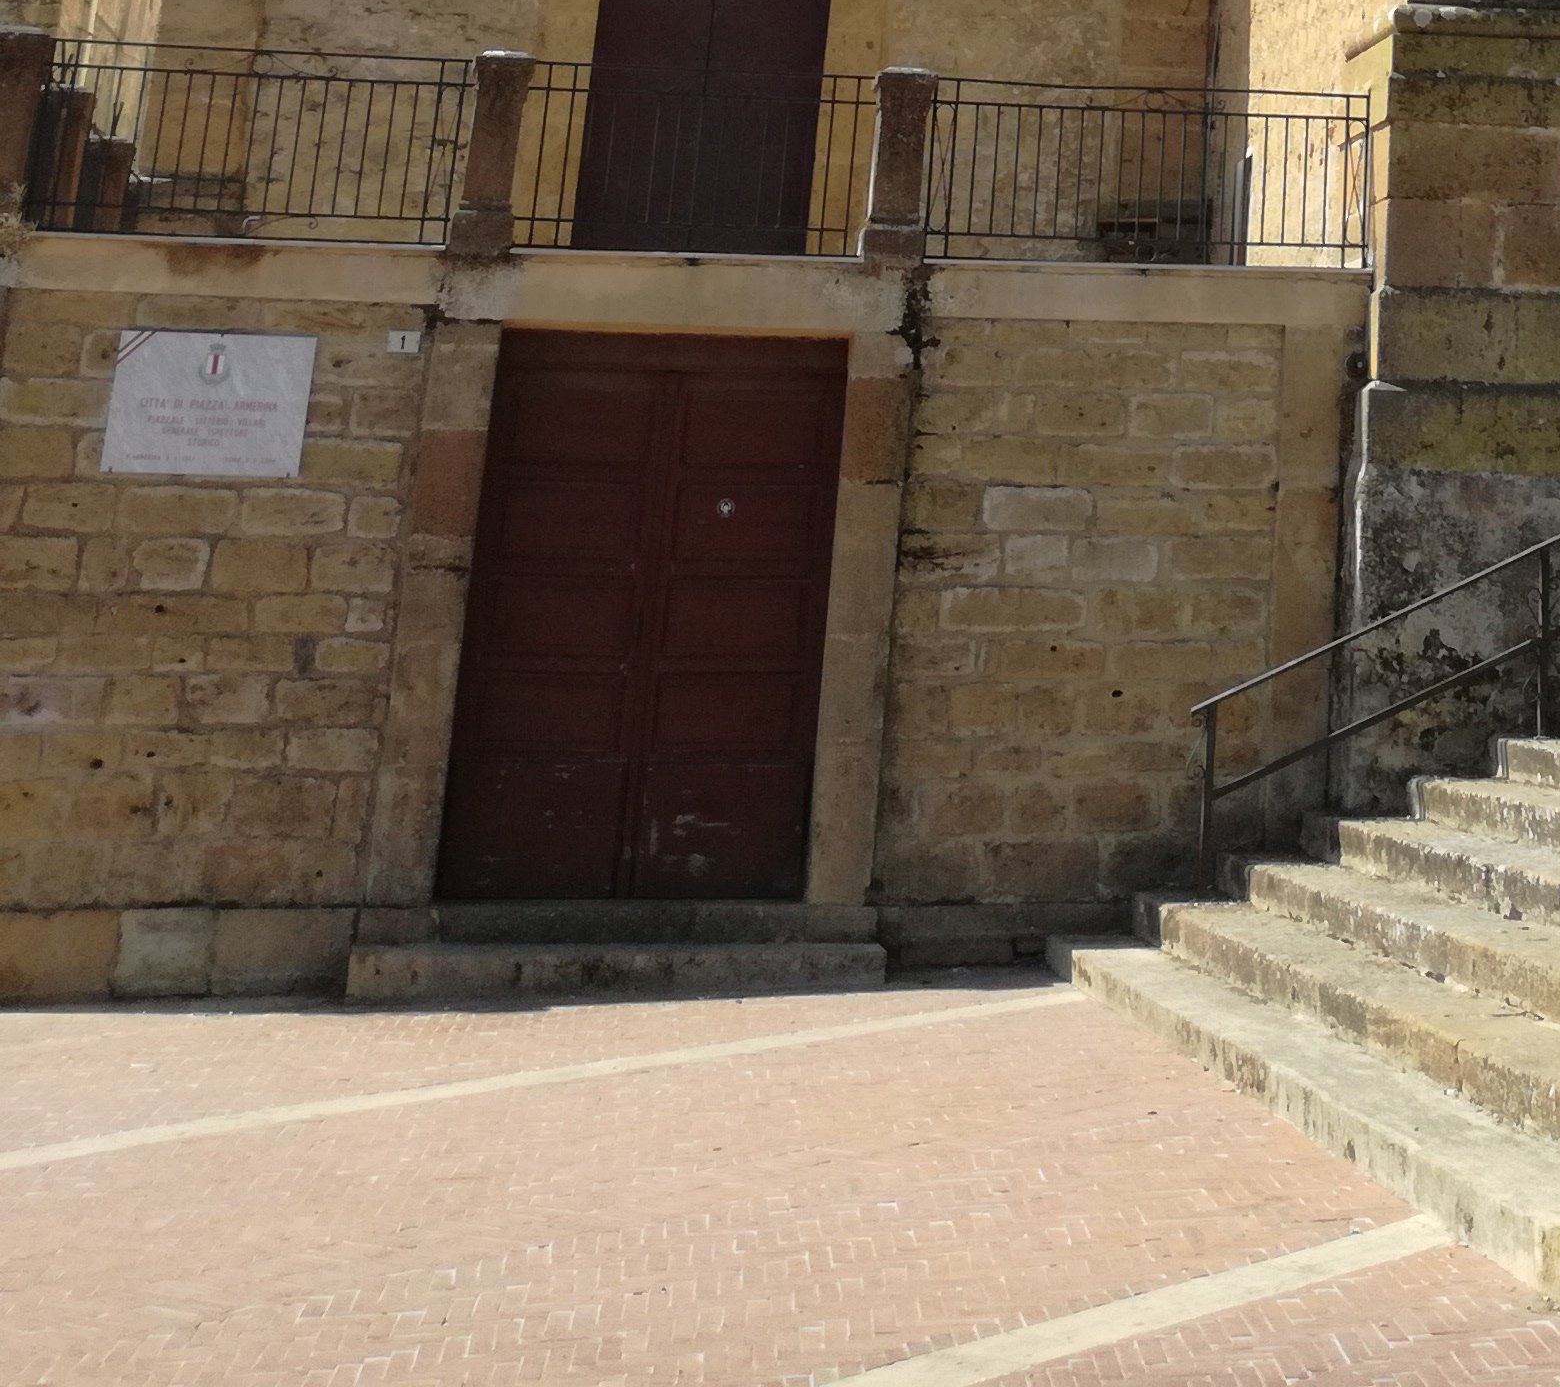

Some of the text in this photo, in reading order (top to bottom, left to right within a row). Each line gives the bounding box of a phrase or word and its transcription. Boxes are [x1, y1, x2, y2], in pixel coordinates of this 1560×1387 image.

[399, 334, 407, 350] 1
[173, 398, 184, 409] DI
[190, 399, 225, 411] PIAZZA
[232, 400, 278, 412] ARMERINA
